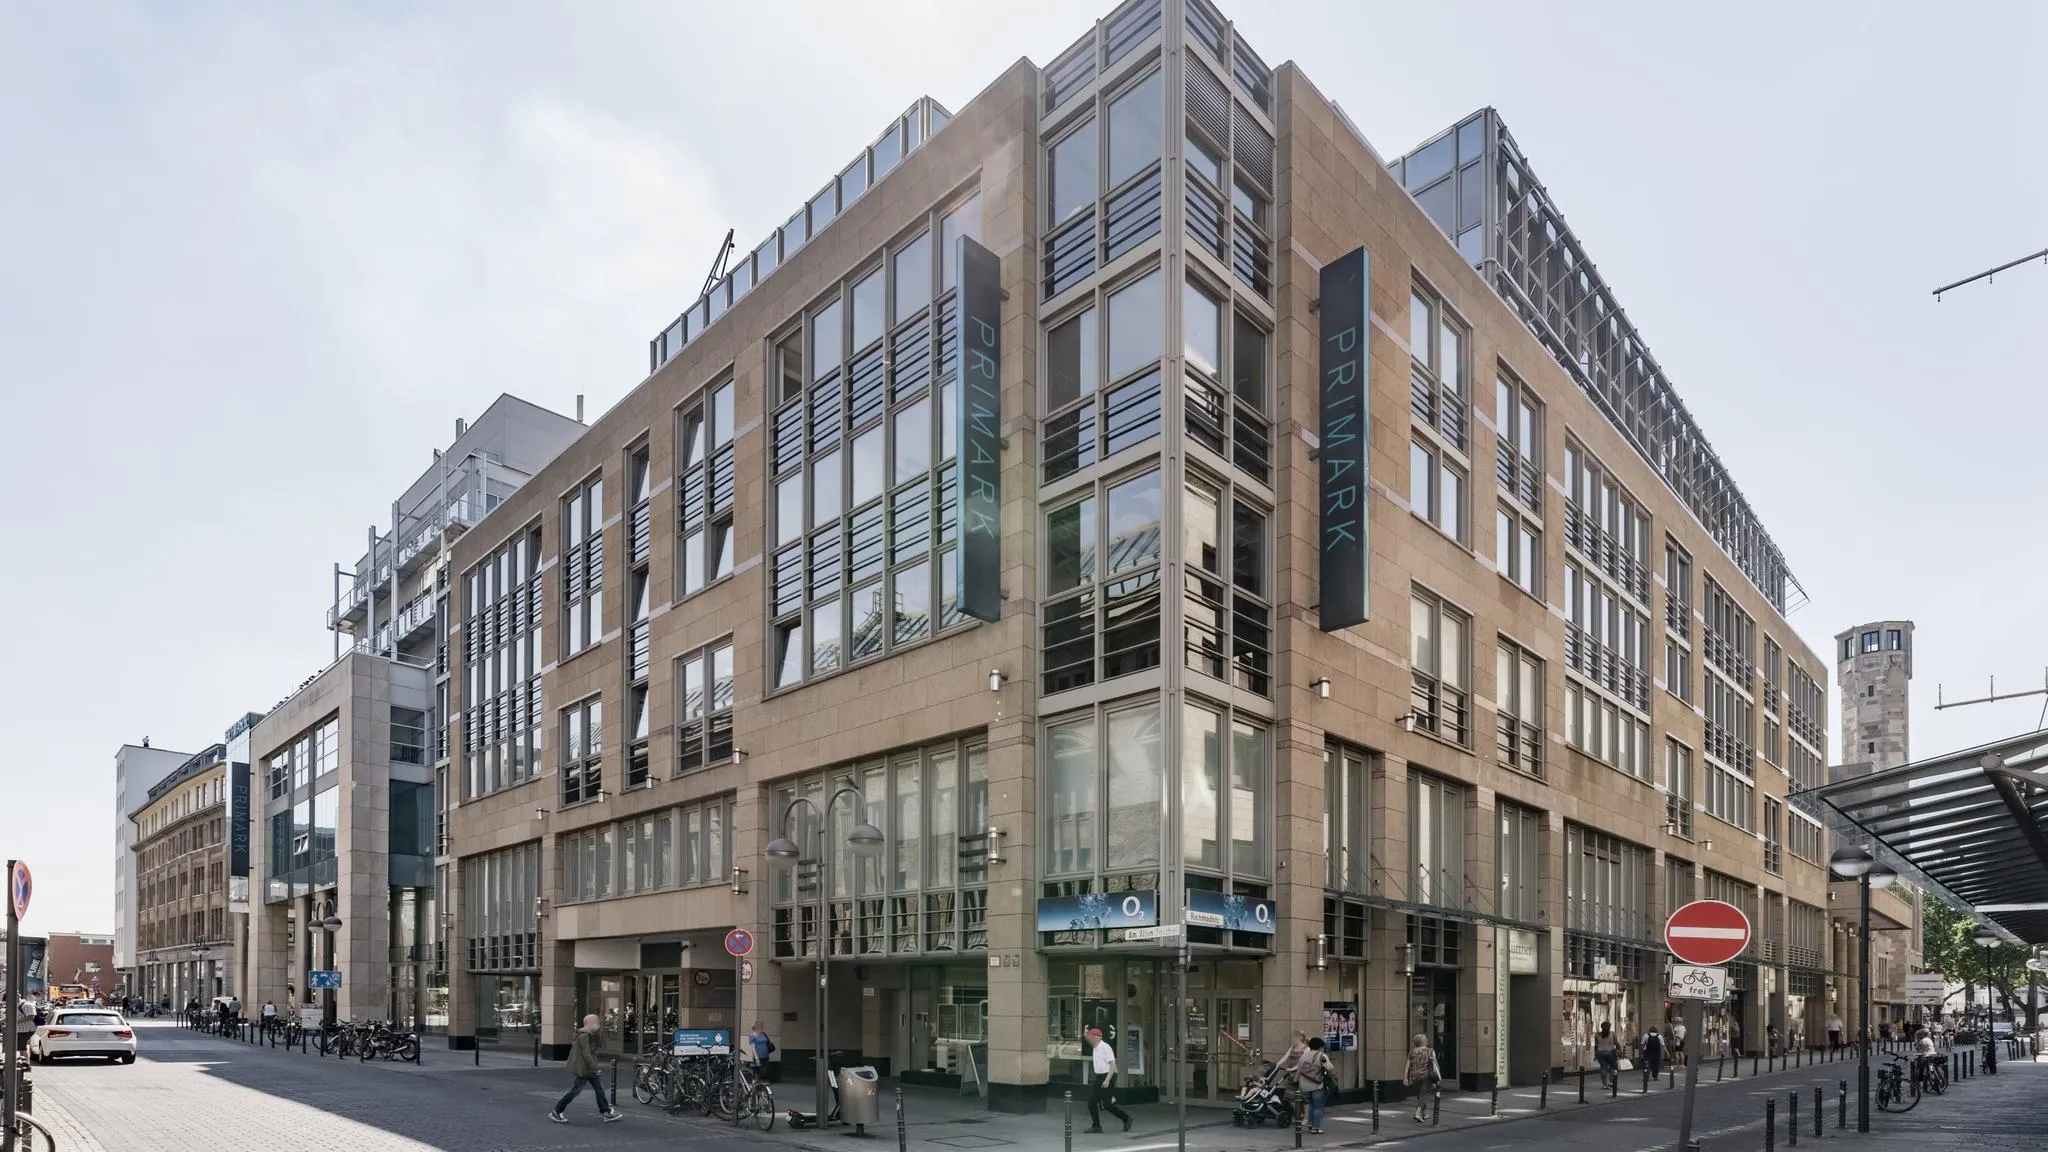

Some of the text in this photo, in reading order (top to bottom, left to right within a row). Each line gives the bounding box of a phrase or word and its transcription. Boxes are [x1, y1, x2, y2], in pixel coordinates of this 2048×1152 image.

[971, 315, 995, 540] PRIMARK
[1326, 326, 1356, 551] PRIMARK
[233, 784, 248, 854] PRIMARK
[27, 958, 41, 978] PURE
[1498, 960, 1506, 1005] Office
[1689, 986, 1707, 995] frei
[1498, 1009, 1506, 1076] Richmod
